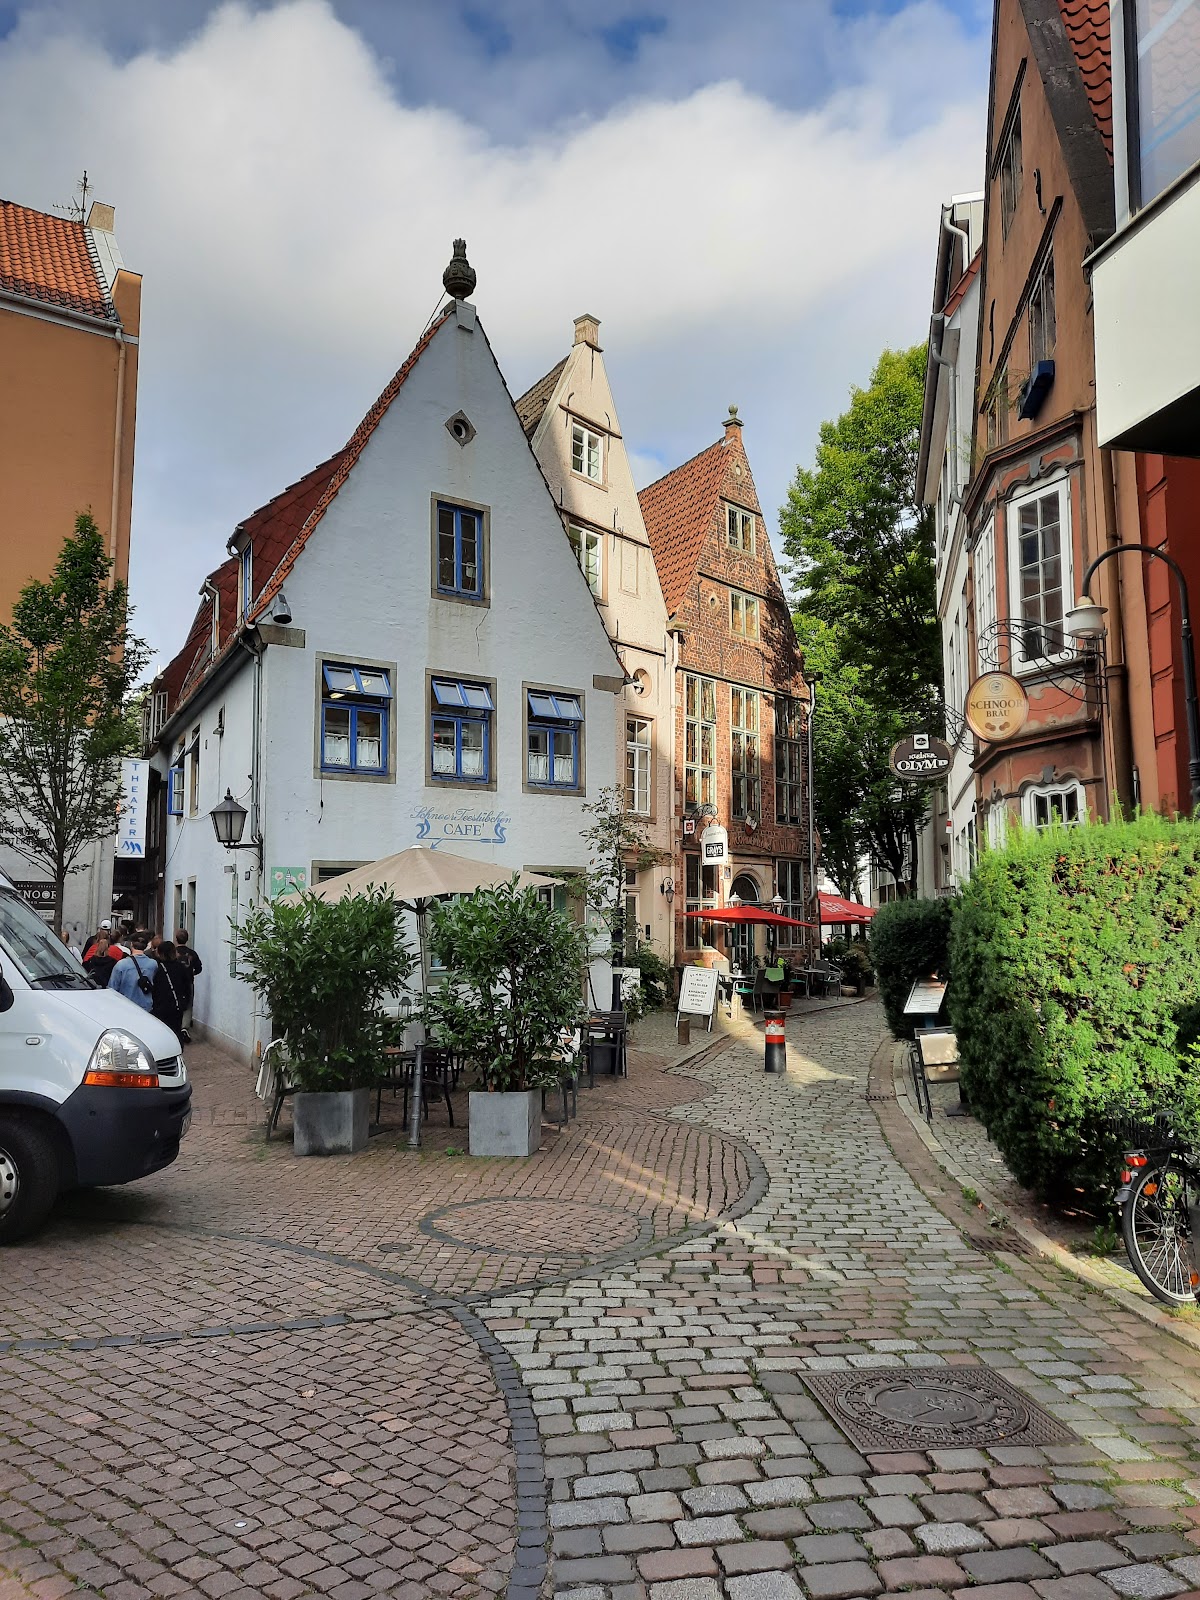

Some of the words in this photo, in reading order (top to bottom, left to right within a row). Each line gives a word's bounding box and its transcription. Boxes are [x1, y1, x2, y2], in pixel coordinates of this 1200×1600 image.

[971, 699, 1023, 710] SCHNOOR
[128, 763, 140, 836] THEATER
[409, 805, 457, 821] Schnoor
[455, 808, 512, 824] Teestübchen
